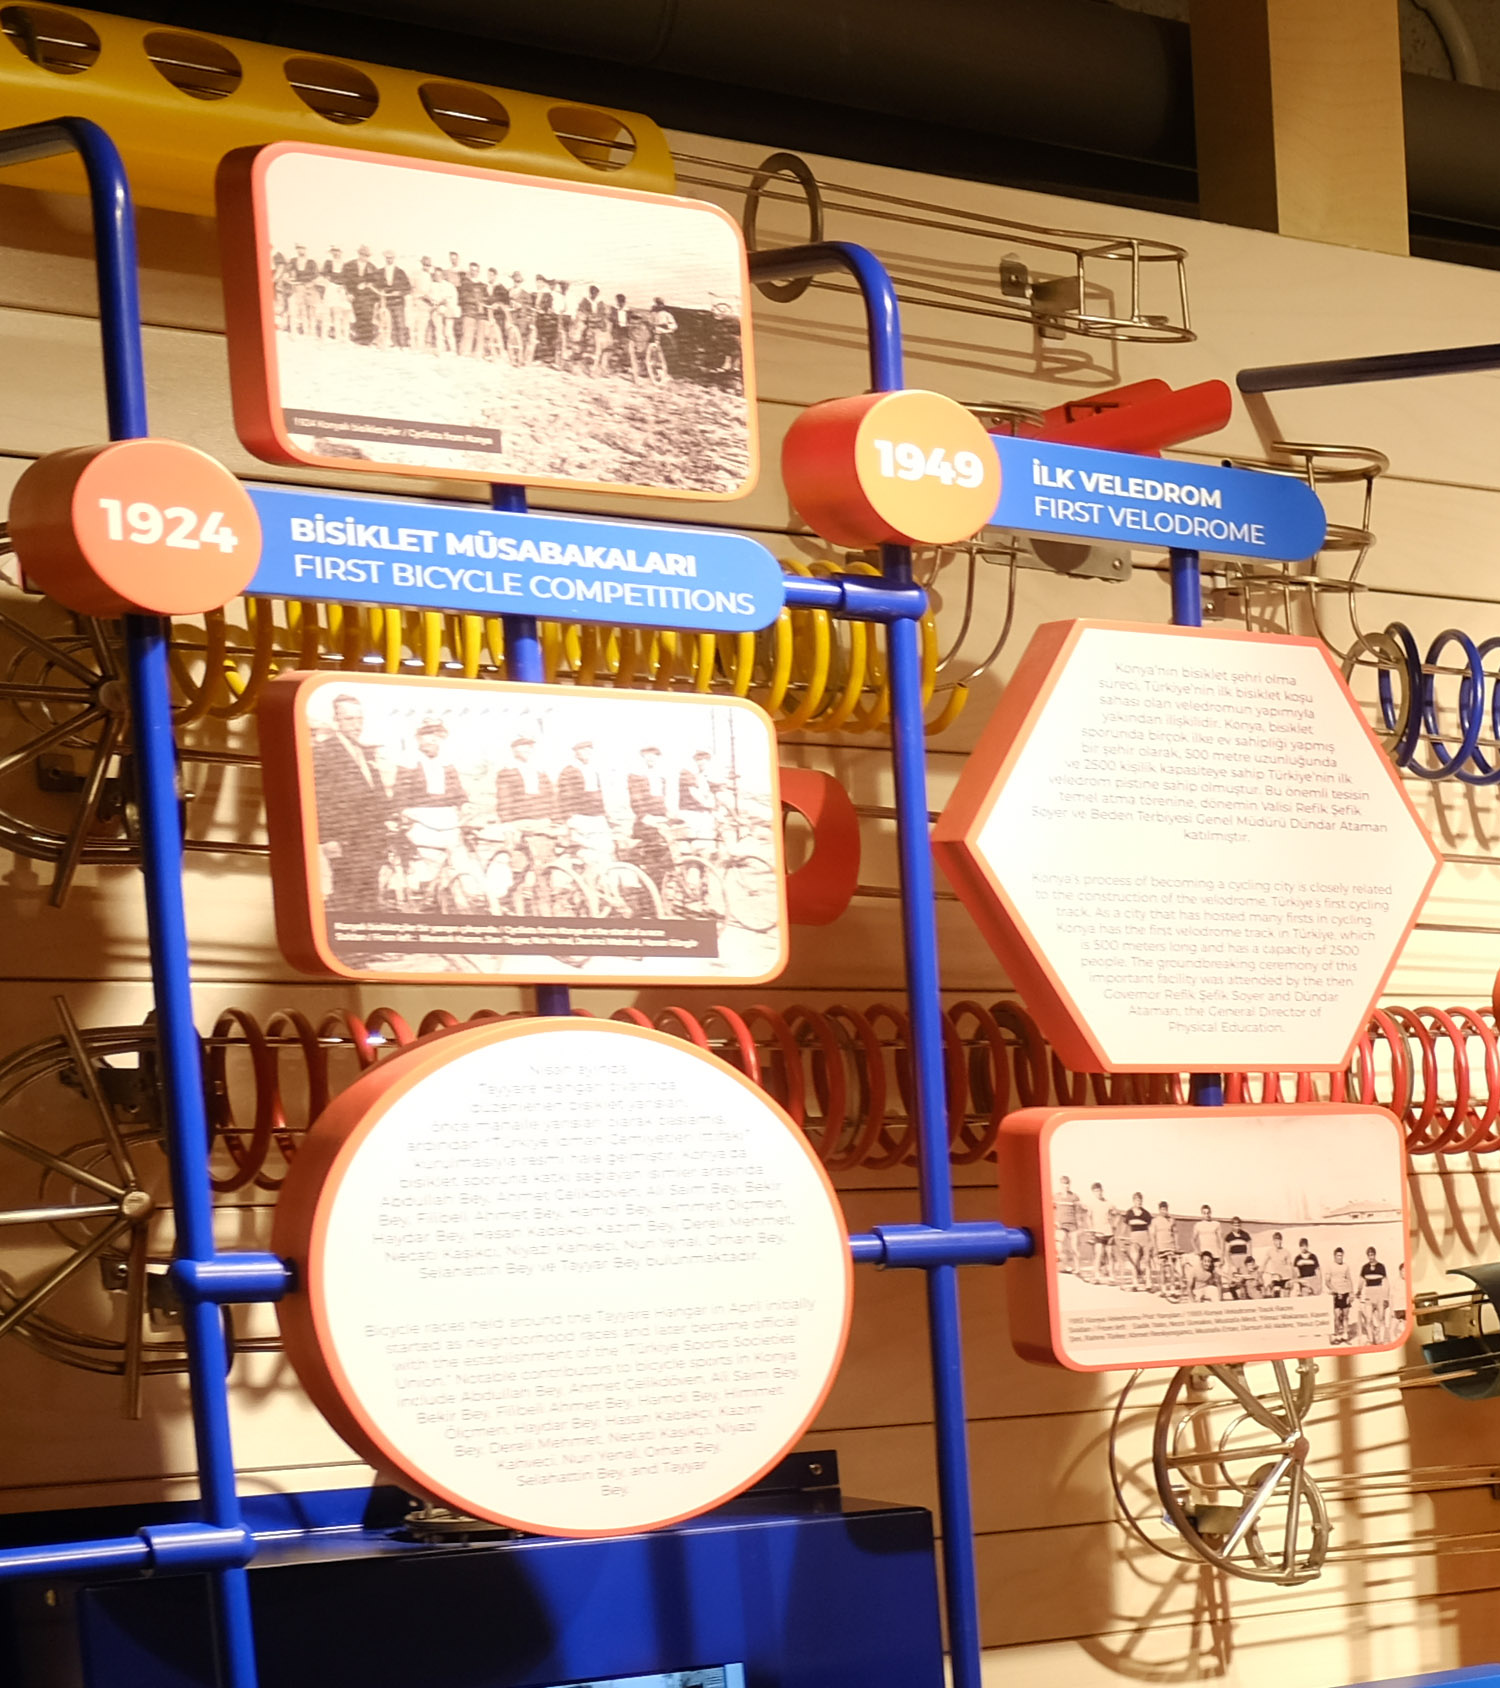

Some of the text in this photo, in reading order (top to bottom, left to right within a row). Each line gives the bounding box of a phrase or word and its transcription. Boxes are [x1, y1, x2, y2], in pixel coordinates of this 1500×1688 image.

[874, 438, 985, 490] 1949
[1032, 458, 1222, 508] İLK VELEDROM
[100, 498, 239, 555] 1924
[1034, 495, 1264, 544] FIRST VELODROME
[290, 517, 697, 576] BİSİKLET MÜSABAKALARI
[293, 553, 756, 614] FIRST BICYCLE COMPETITIONS
[1181, 666, 1228, 680] bisiklet
[1264, 673, 1297, 685] olma
[1143, 697, 1171, 708] olan
[1174, 700, 1252, 714] veledromun
[1268, 721, 1314, 734] bisiklet
[1130, 956, 1153, 967] The
[1156, 957, 1256, 971] groundbreaking
[1258, 961, 1318, 972] ceremony
[1320, 960, 1333, 970] of
[1335, 960, 1357, 970] this
[1091, 972, 1154, 985] important
[1156, 973, 1196, 986] facility
[1199, 976, 1224, 984] was
[1227, 974, 1282, 985] attended
[1285, 975, 1299, 987] by
[1302, 975, 1323, 985] the
[1183, 1005, 1205, 1015] the
[1207, 1005, 1255, 1016] General
[1258, 1006, 1306, 1016] Director
[1167, 1021, 1217, 1034] Physical
